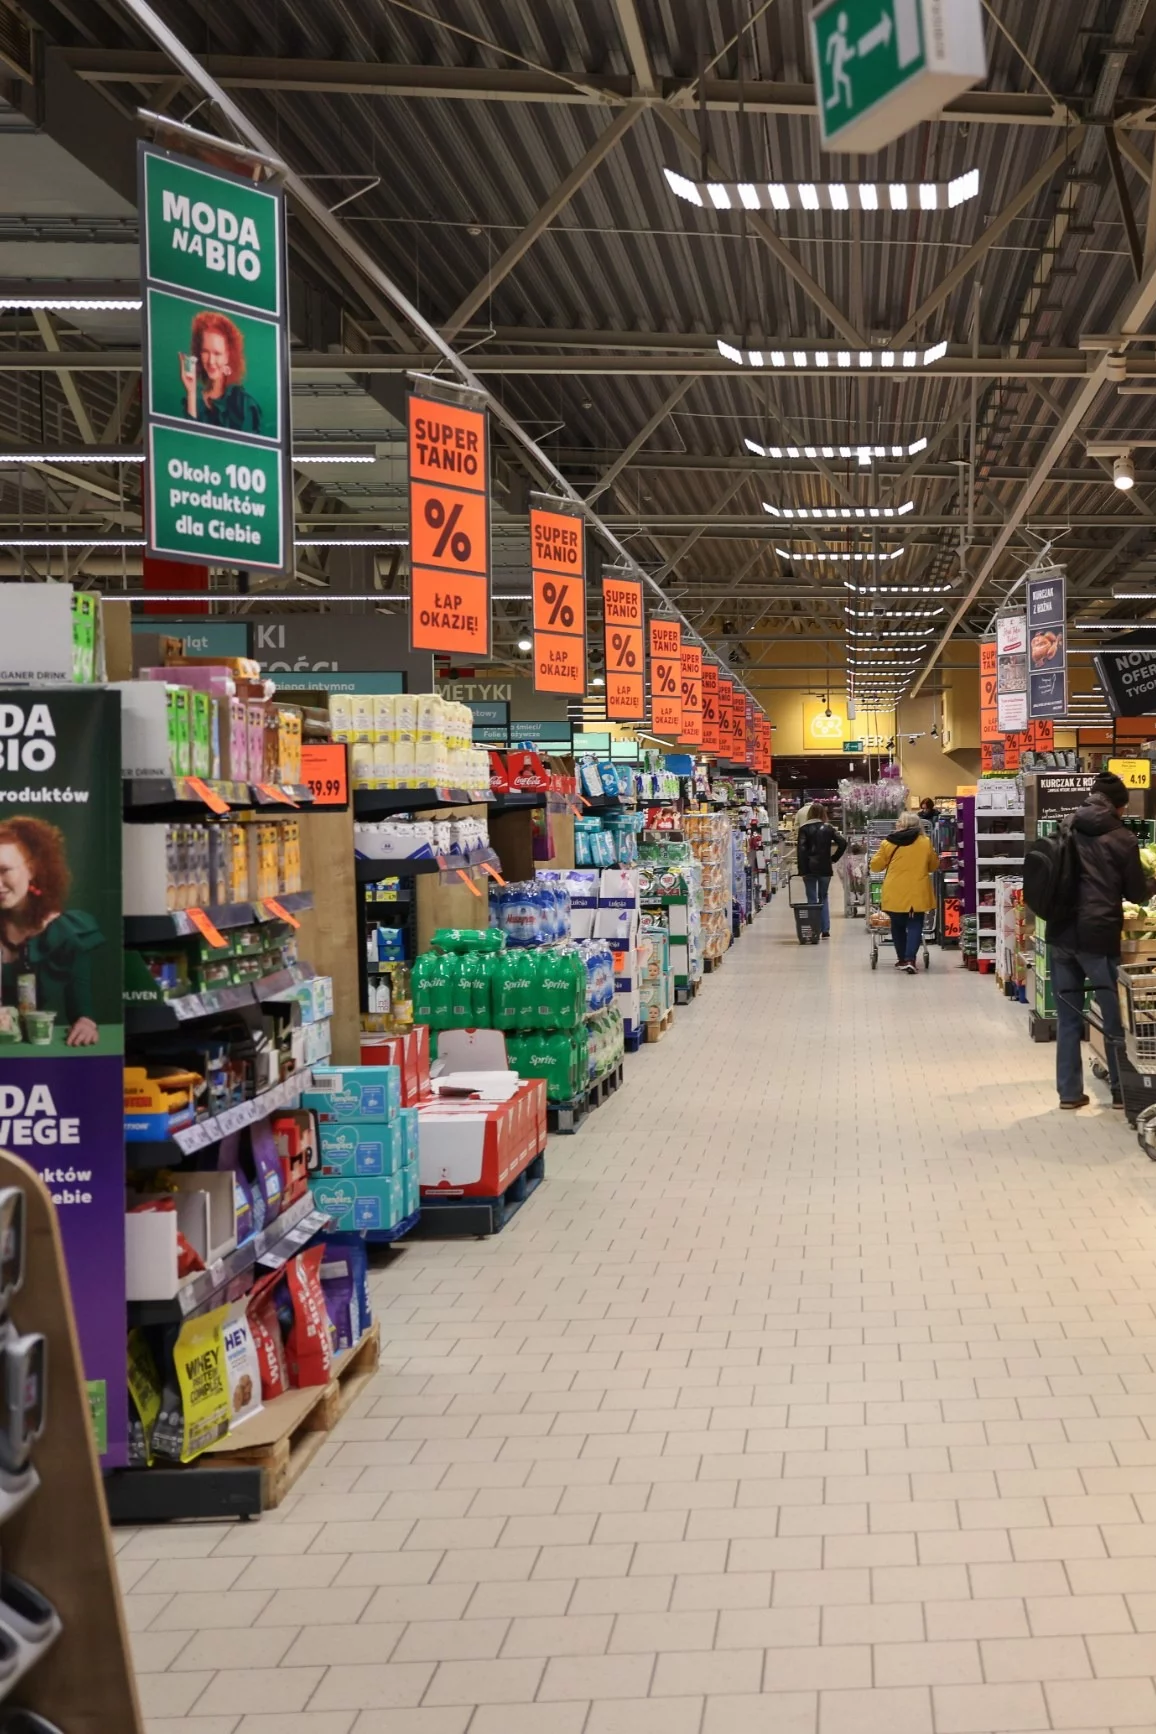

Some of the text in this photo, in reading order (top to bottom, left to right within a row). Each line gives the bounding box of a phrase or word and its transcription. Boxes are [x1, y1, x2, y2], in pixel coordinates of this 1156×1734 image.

[162, 190, 260, 250] MODA
[172, 227, 261, 281] NA BIO
[415, 418, 478, 453] SUPER
[416, 443, 478, 476] TANIO
[168, 458, 266, 494] Około 100
[170, 487, 266, 518] produktów
[175, 515, 261, 546] dla Ciebie
[424, 498, 472, 562] %
[535, 524, 578, 548] SUPER
[535, 542, 577, 565] TANIO
[434, 592, 462, 610] ŁAP
[542, 582, 574, 627] %
[606, 589, 638, 605] SUPER
[607, 603, 638, 618] TANIO
[420, 609, 479, 636] OKAZJĘ!
[257, 625, 286, 649] KI
[652, 629, 678, 641] SUPER
[612, 633, 636, 668] %
[653, 640, 678, 652] TANIO
[550, 650, 568, 662] ŁAP
[681, 653, 699, 663] UPER
[37, 670, 66, 680] DRINK
[540, 664, 579, 680] OKAZJĘ!
[656, 665, 676, 692] %
[433, 683, 511, 702] METYKI
[617, 685, 631, 695] ŁAP
[682, 682, 697, 706] %
[610, 695, 640, 708] OKAZJĘ!
[661, 707, 673, 715] ŁAP
[0, 704, 56, 738] DA
[503, 730, 541, 740] sożywcze
[0, 739, 56, 772] IO
[308, 780, 340, 796] 39.99
[1041, 778, 1074, 788] KURCZAK
[1076, 778, 1081, 787] Z
[1130, 775, 1146, 784] 4.19
[0, 787, 89, 804] roduktów
[418, 977, 446, 991] Sprite
[457, 977, 485, 991] Sprite
[503, 979, 531, 991] Sprite
[542, 978, 570, 991] Sprite
[529, 1053, 557, 1067] Sprite
[0, 1084, 57, 1117] DA
[185, 1346, 220, 1381] WHEY
